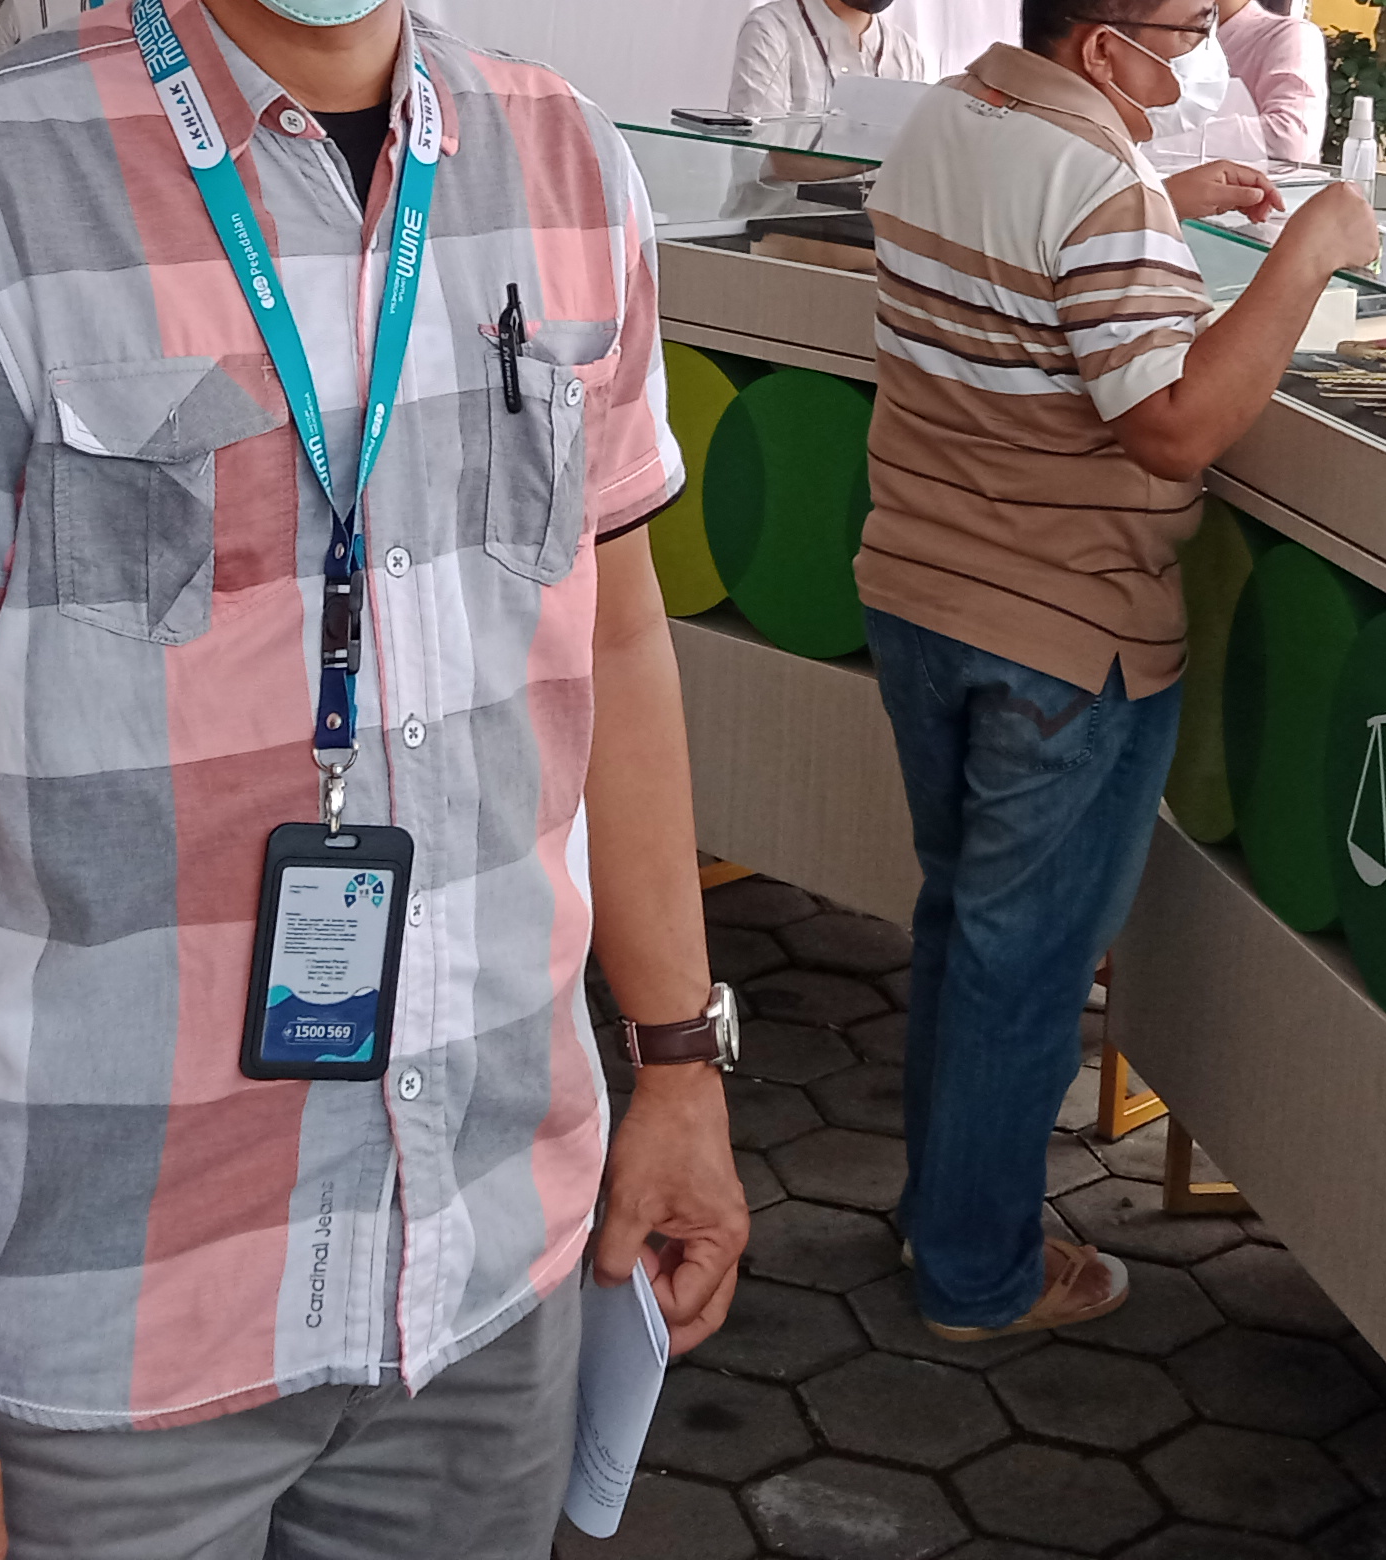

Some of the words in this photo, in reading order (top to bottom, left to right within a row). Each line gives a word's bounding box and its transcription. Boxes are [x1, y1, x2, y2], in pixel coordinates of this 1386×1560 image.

[169, 83, 208, 150] AKHLAK
[423, 85, 433, 149] AKHLAK
[231, 212, 262, 276] Pegadaian
[396, 207, 422, 277] BUMN
[295, 1025, 325, 1038] 1500
[327, 1025, 351, 1038] 569
[315, 1180, 334, 1238] Jeans
[306, 1241, 330, 1328] Cardinal
